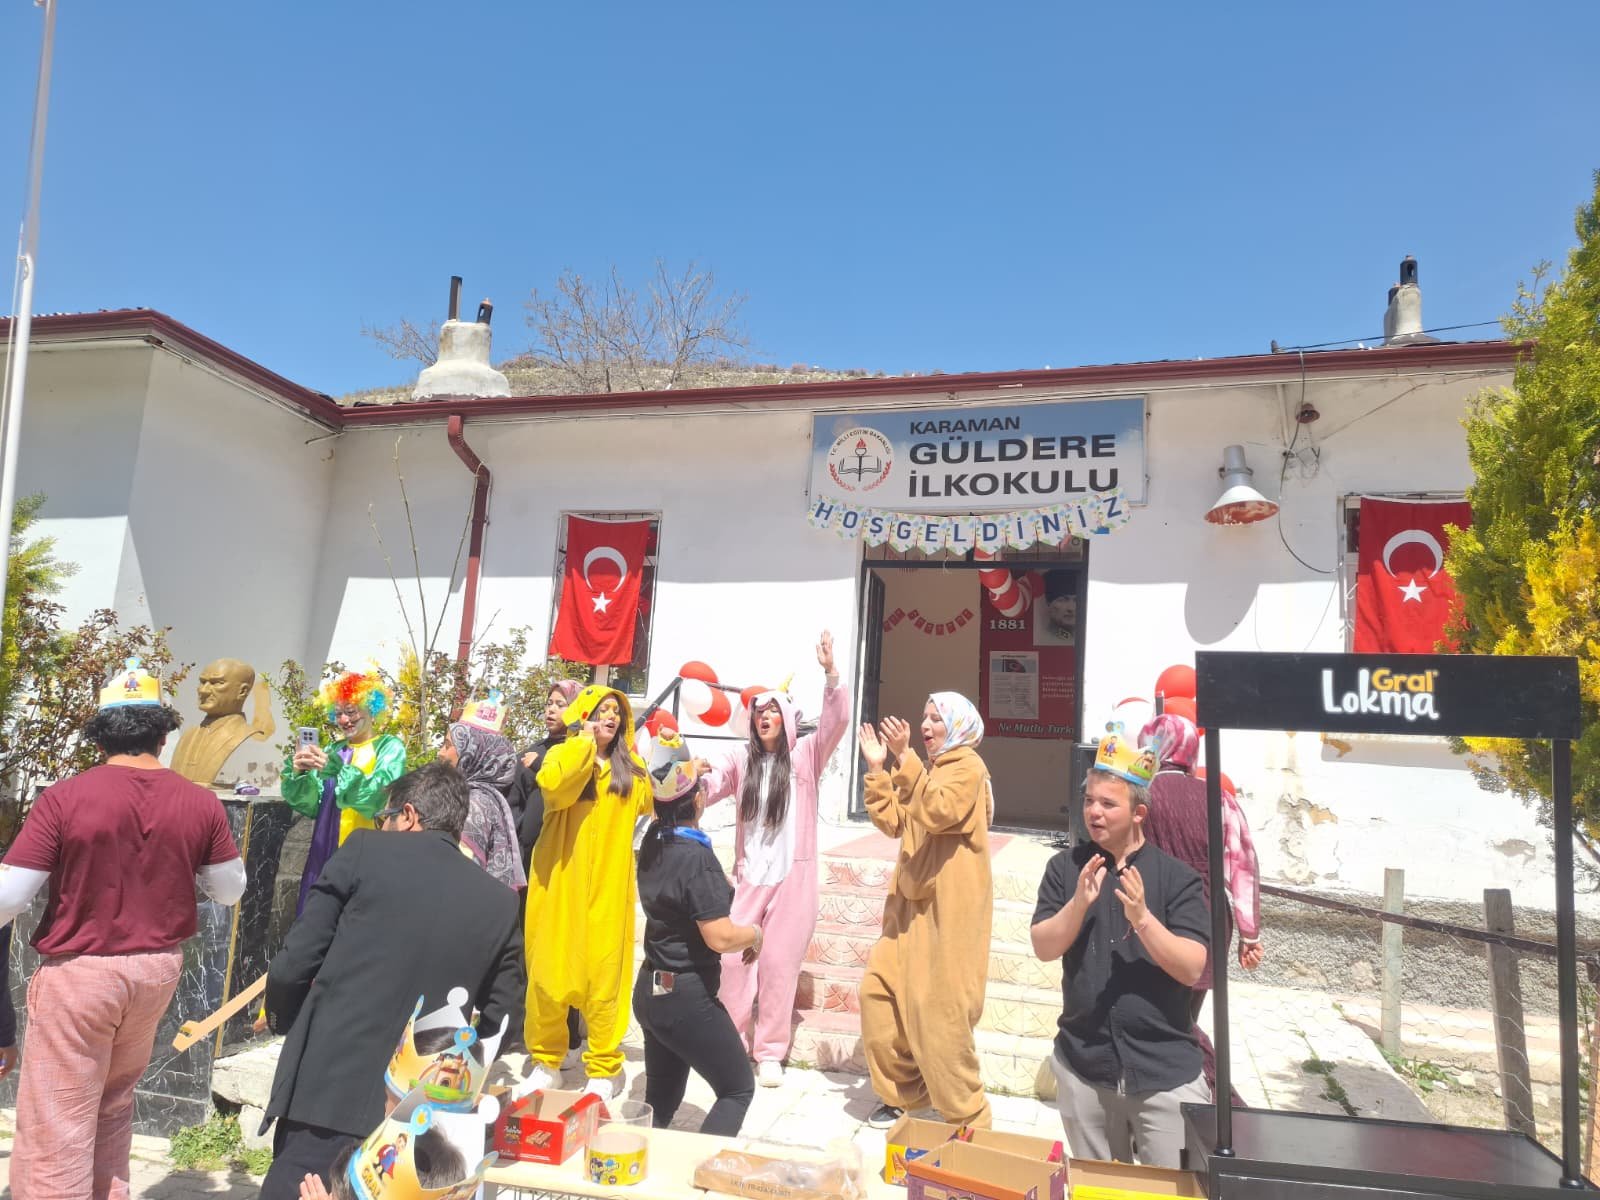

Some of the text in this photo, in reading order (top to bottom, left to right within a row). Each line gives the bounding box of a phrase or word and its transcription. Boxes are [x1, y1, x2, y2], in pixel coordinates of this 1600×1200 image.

[909, 416, 1021, 435] KARAMAN
[908, 434, 1117, 465] GÜLDERE
[908, 468, 1119, 498] İLKOKULU
[989, 619, 1025, 630] 1881
[1371, 667, 1434, 692] Gral
[1322, 668, 1439, 721] Lokma
